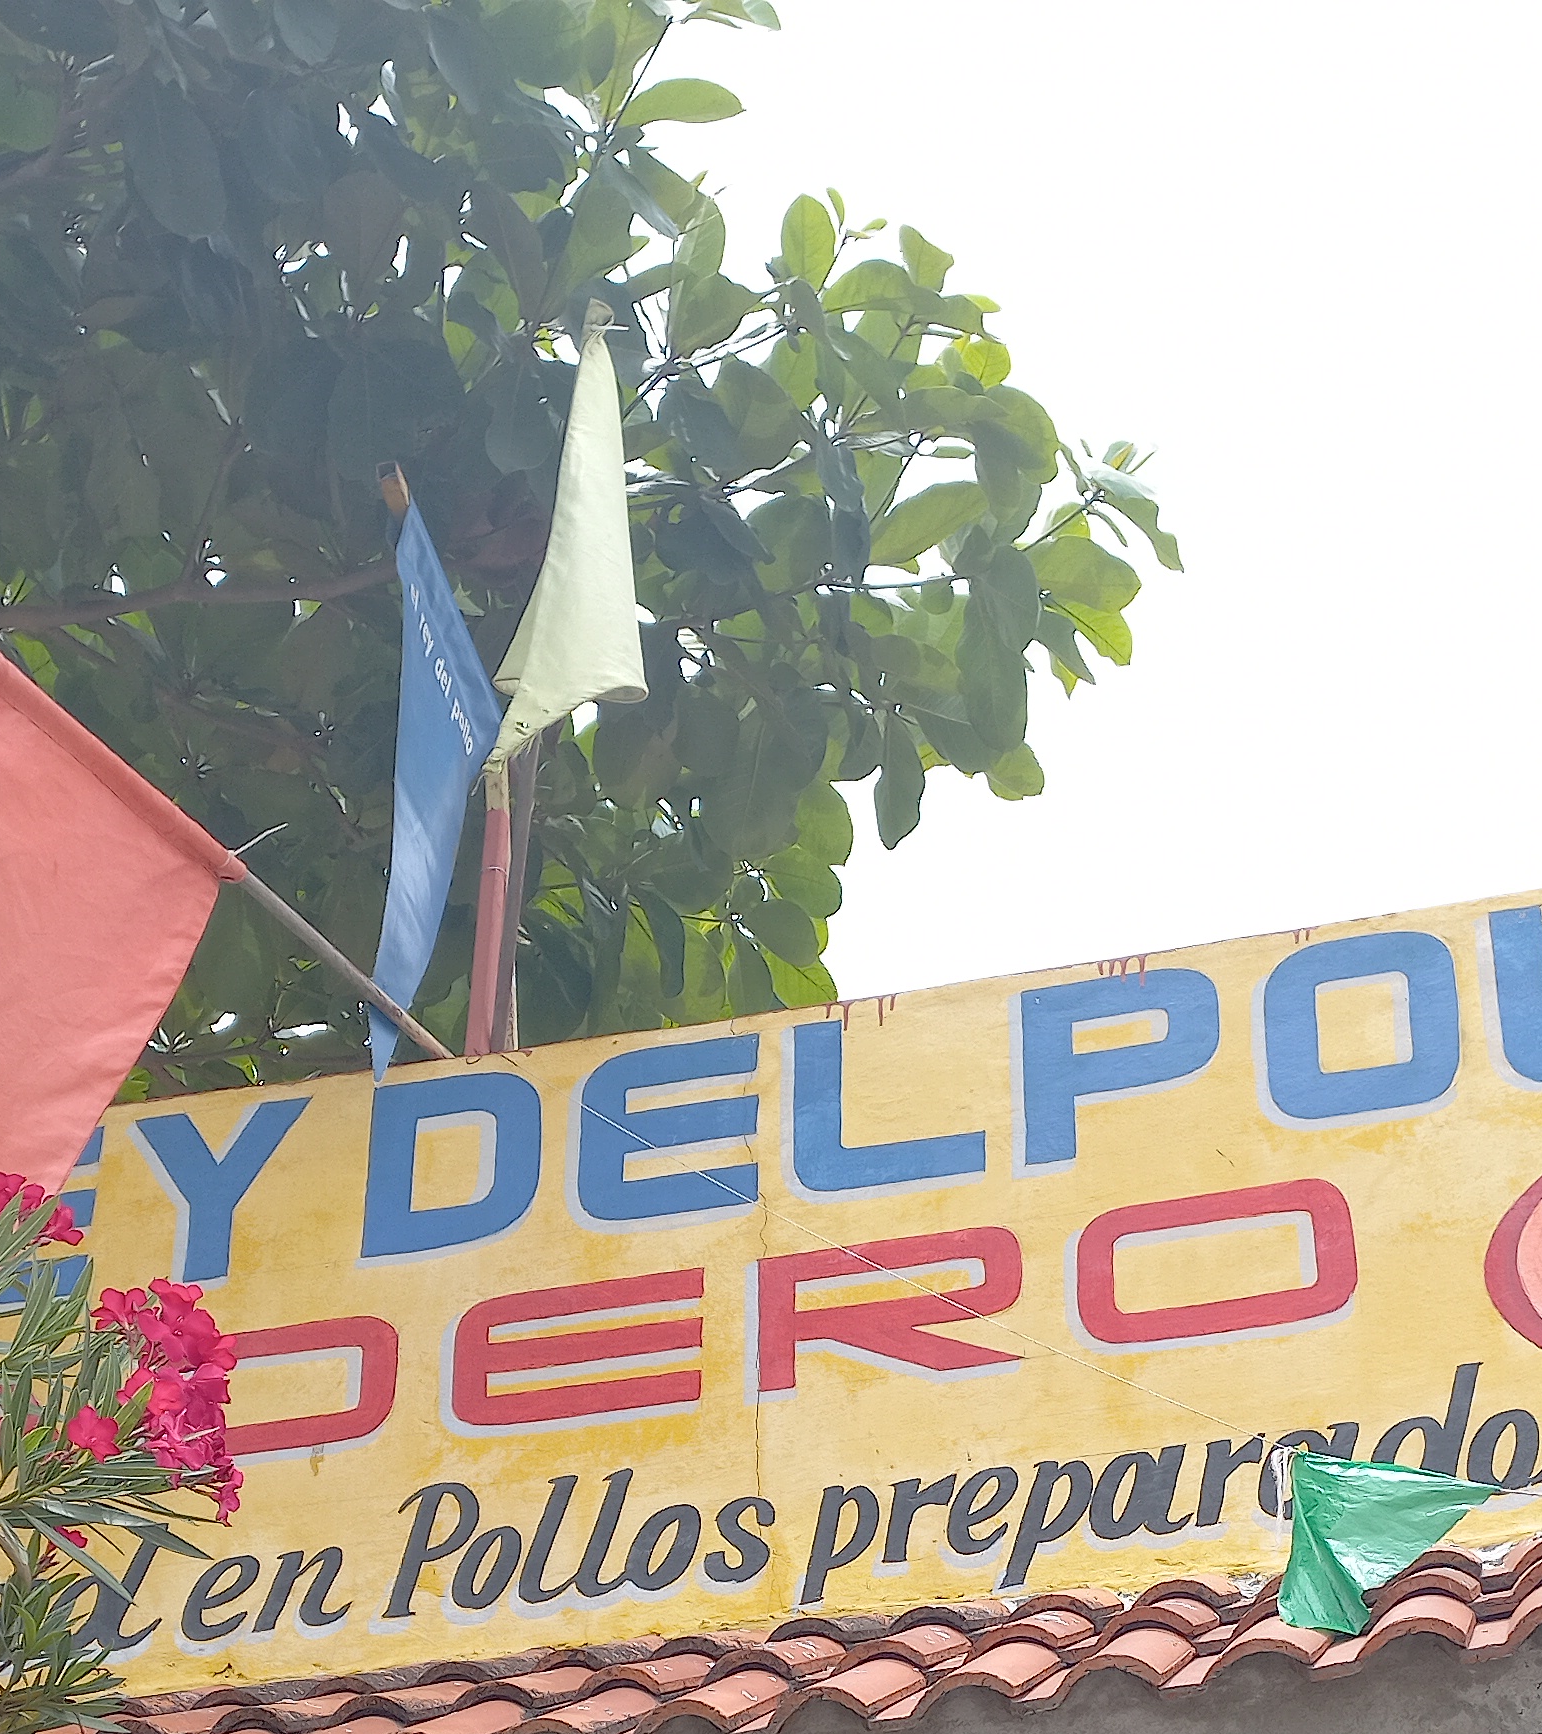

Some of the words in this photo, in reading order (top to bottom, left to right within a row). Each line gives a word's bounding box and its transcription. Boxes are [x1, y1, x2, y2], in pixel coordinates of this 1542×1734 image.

[434, 656, 453, 699] del
[449, 697, 474, 756] pollo
[359, 1019, 987, 1262] DEL
[179, 1545, 351, 1643] en
[383, 1467, 776, 1620] Pollos
